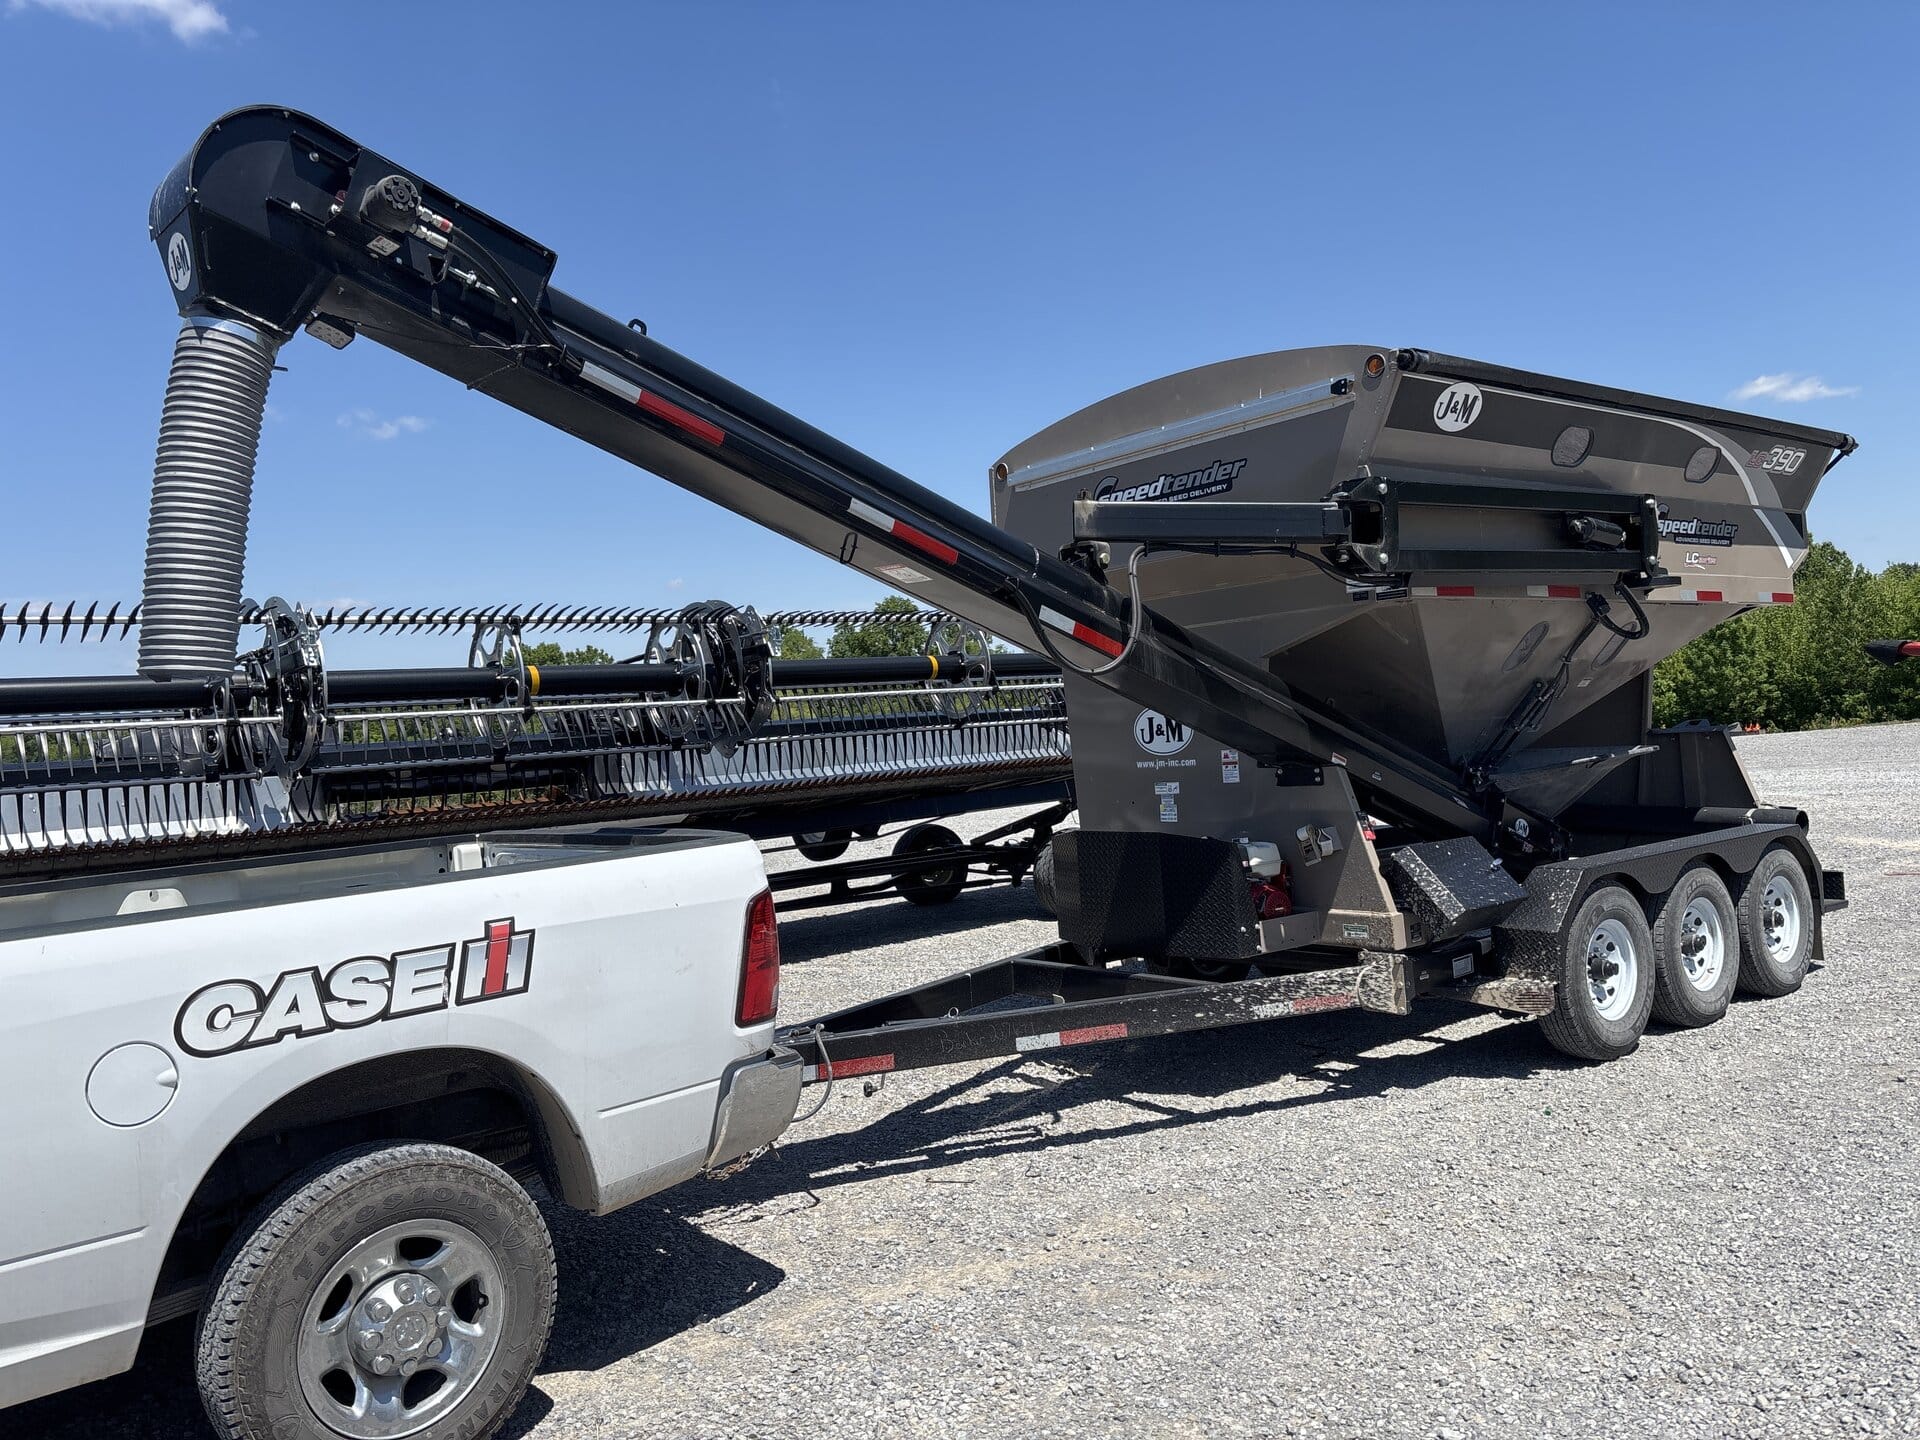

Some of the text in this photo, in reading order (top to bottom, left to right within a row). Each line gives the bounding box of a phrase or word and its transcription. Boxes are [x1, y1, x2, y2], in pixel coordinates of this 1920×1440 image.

[169, 238, 191, 284] J&M
[1436, 391, 1480, 424] J&M
[1189, 483, 1228, 498] DELIVERY
[1140, 716, 1184, 745] J&M
[1136, 758, 1197, 770] www.jm-inc.com
[174, 942, 456, 1058] CASE
